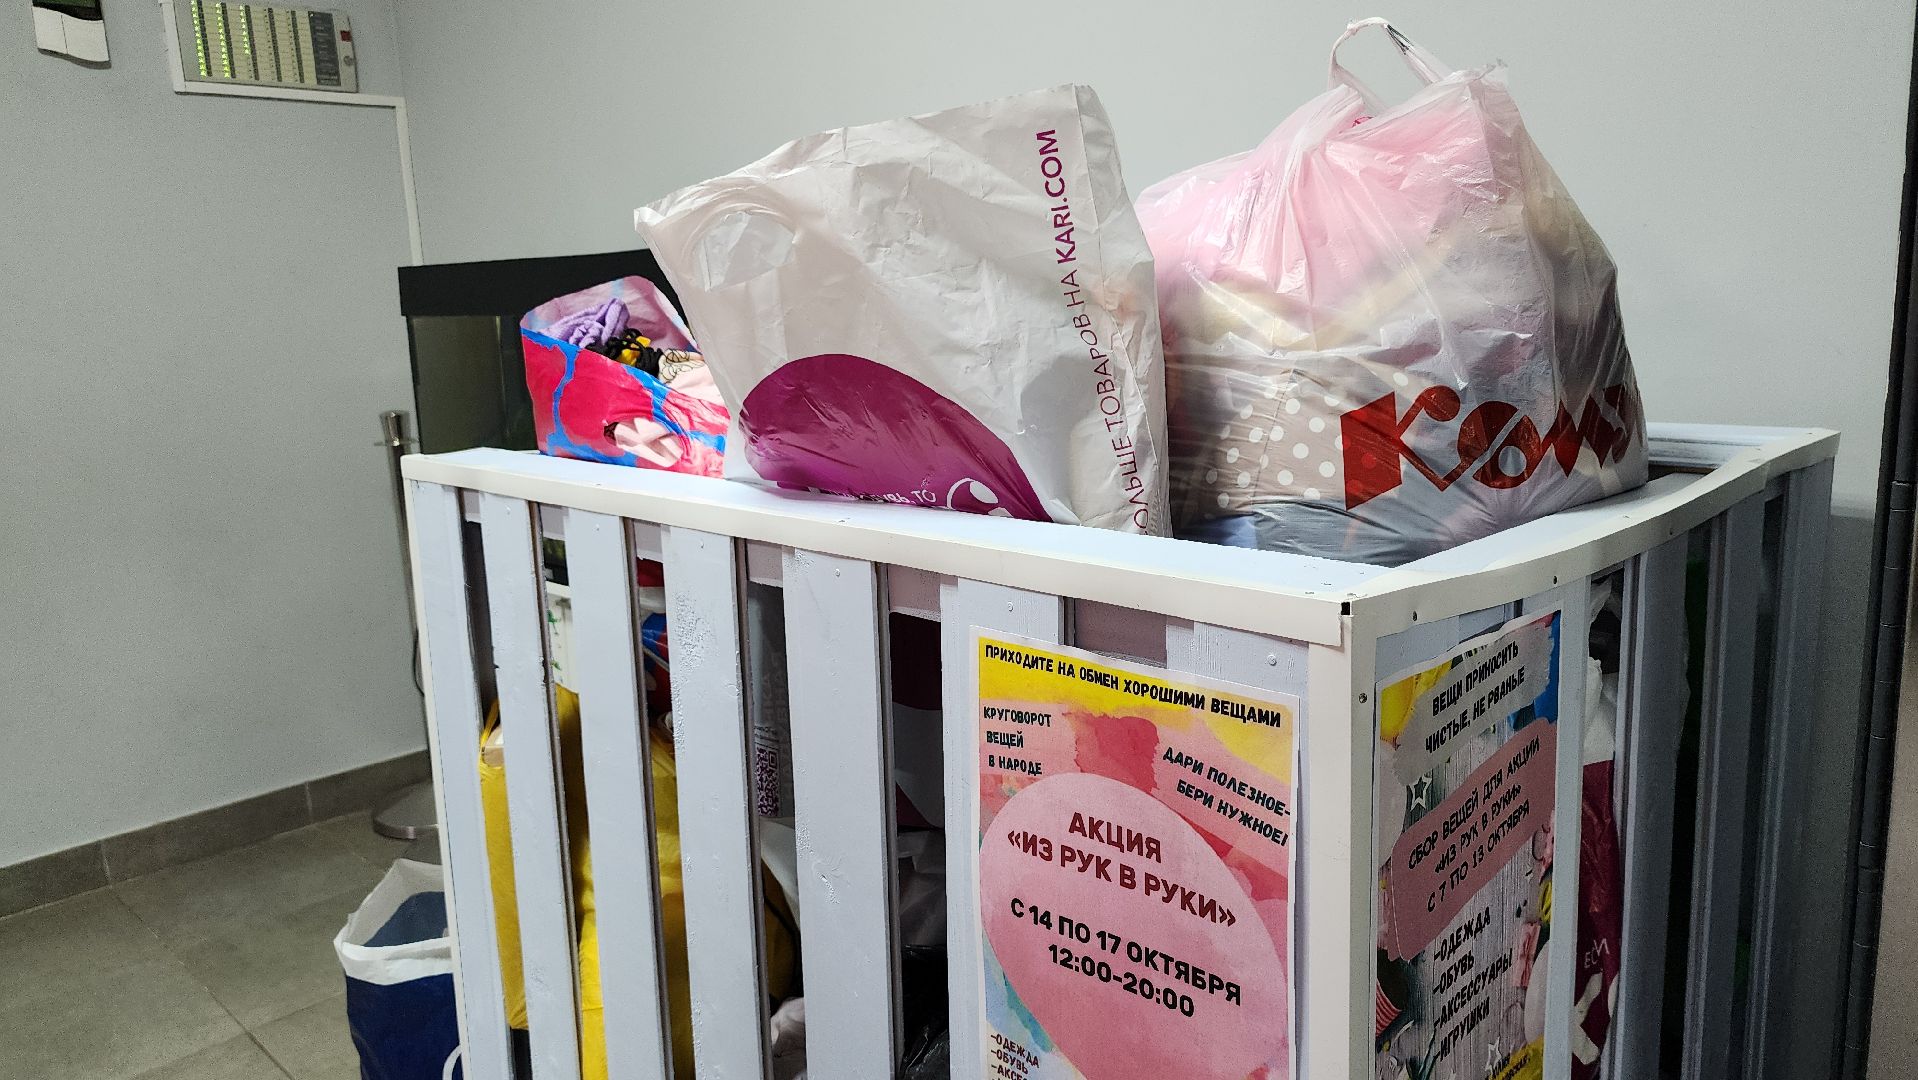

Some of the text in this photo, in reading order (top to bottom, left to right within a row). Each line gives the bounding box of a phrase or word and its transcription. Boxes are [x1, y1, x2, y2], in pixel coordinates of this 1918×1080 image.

[1036, 129, 1149, 534] ОЛЬШЕ ТОВАРОВ НА KARI.COM
[985, 645, 1281, 728] ПРИХОДИТЕ НА ОБМЕН ХОРОШИМИ ВЕЩАМИ
[1432, 641, 1519, 717] ВЕЩИ ПРИНОСИТЬ
[983, 706, 1052, 728] КРУГОВОРОТ
[986, 731, 1024, 749] ВЕЩЕЙ
[1425, 706, 1471, 754] ЧИСТЫЕ,
[1473, 698, 1487, 721] НЕ
[988, 754, 1042, 776] В НАРОДЕ
[1163, 747, 1291, 817] ДАРИ ПОЛЕЗНОЕ-
[1176, 780, 1289, 847] БЕРИ НУЖНОЕ!
[1408, 735, 1540, 869] СБОР ВЕЩЕЙ ДЛЯ АКЦИИ
[1461, 821, 1479, 851] РУК
[1482, 812, 1488, 831] В
[1068, 812, 1162, 863] АКЦИЯ
[1427, 799, 1530, 912] С 7 ПО 13 ОКТЯБРЯ
[1008, 830, 1236, 927] «ИЗ РУК В РУКИ»
[1010, 898, 1241, 1006] С 14 ПО 17 ОКТЯБРЯ
[1434, 907, 1490, 963] -ОДЕЖДА
[1048, 944, 1194, 1017] 12:00-20:00
[1432, 952, 1475, 995] -ОБУВЬ
